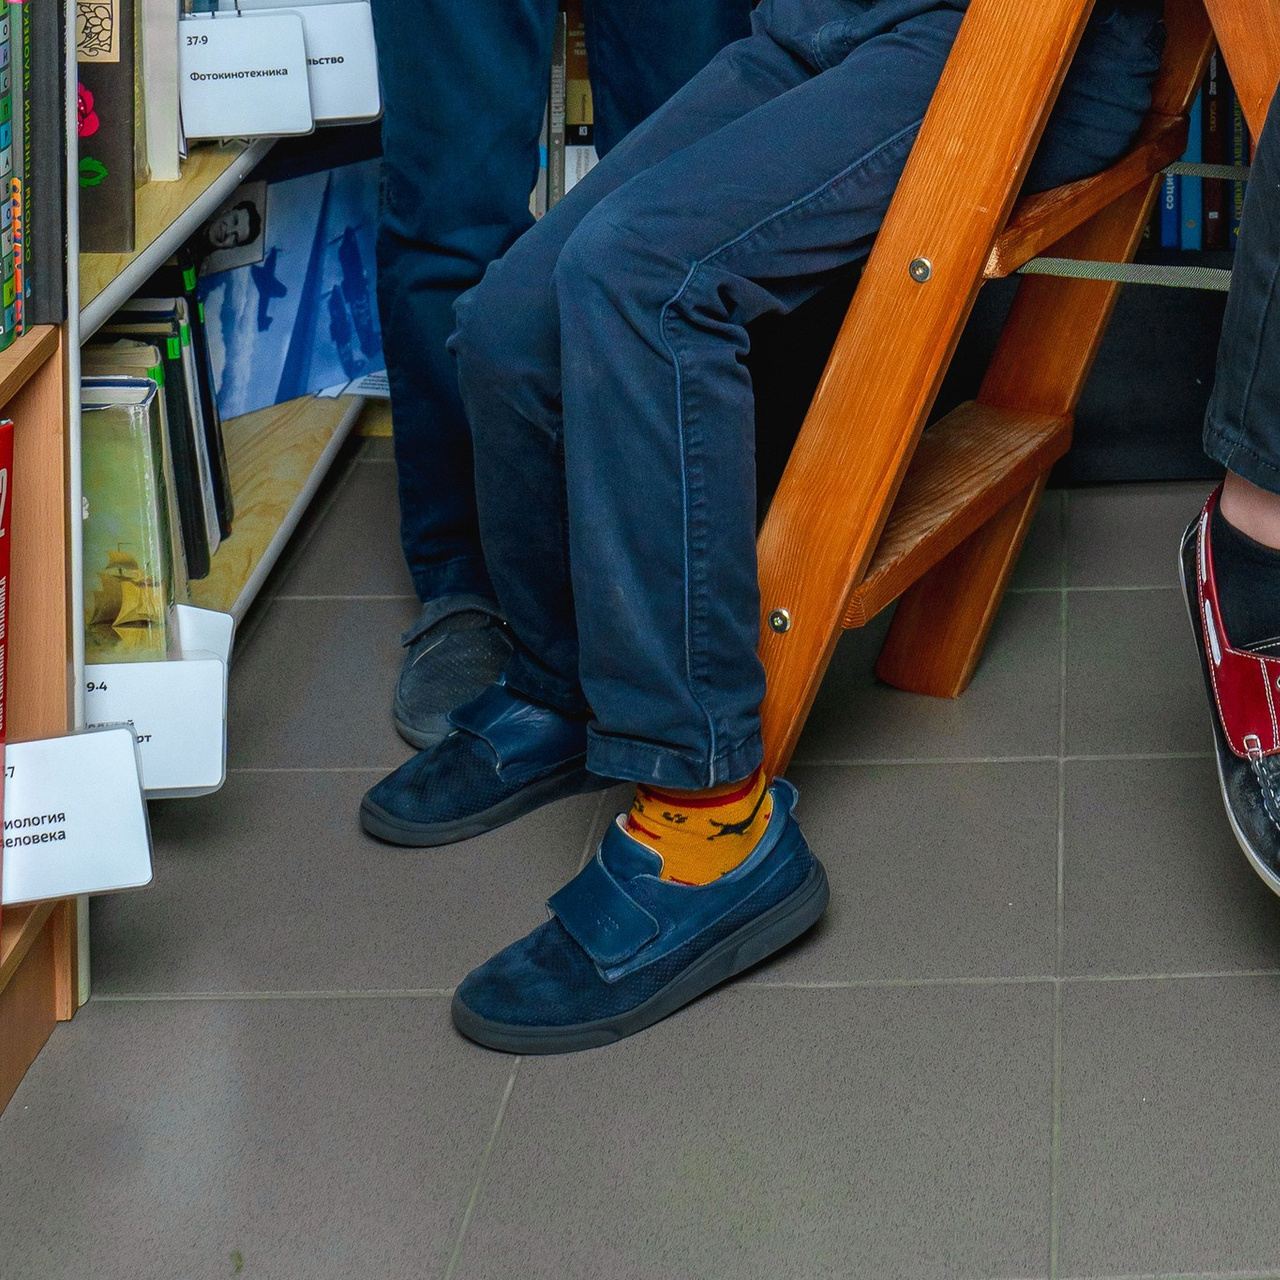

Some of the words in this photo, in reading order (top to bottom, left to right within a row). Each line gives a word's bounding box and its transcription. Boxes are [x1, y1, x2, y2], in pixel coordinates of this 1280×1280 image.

[22, 2, 32, 105] ЧЕЛОВЕКА
[186, 35, 209, 46] 37.9
[189, 67, 289, 83] Фотокинотехника
[23, 113, 32, 183] ГЕНЕТИКИ
[24, 191, 33, 263] ОСНОВЫ
